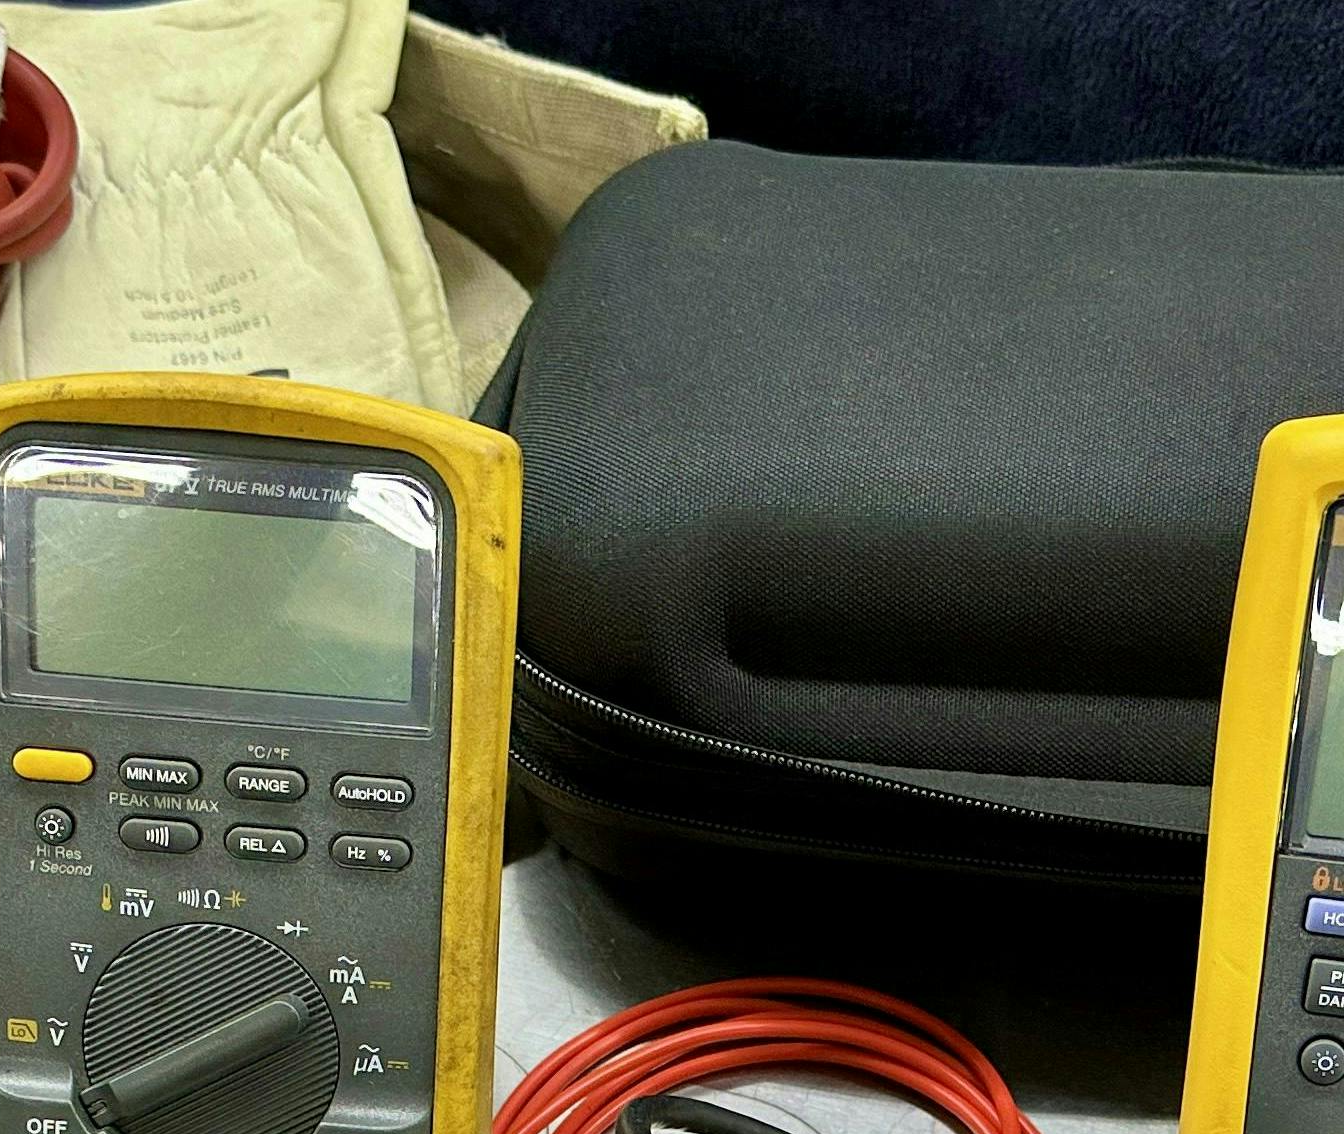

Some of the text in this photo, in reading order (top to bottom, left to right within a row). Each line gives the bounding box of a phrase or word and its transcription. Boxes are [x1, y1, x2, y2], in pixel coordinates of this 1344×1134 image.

[206, 475, 249, 495] TRUE
[251, 482, 285, 498] RMS
[126, 766, 188, 785] MIN MAX
[238, 776, 290, 794] RANGE
[108, 791, 220, 813] PEAK MIN MAX
[338, 785, 406, 805] AutoHOLD
[35, 844, 82, 860] Hi Res
[239, 837, 268, 853] REL
[347, 845, 366, 860] Hz
[39, 859, 93, 876] Second
[119, 899, 155, 918] mV
[329, 966, 365, 985] mA
[341, 986, 358, 1004] A
